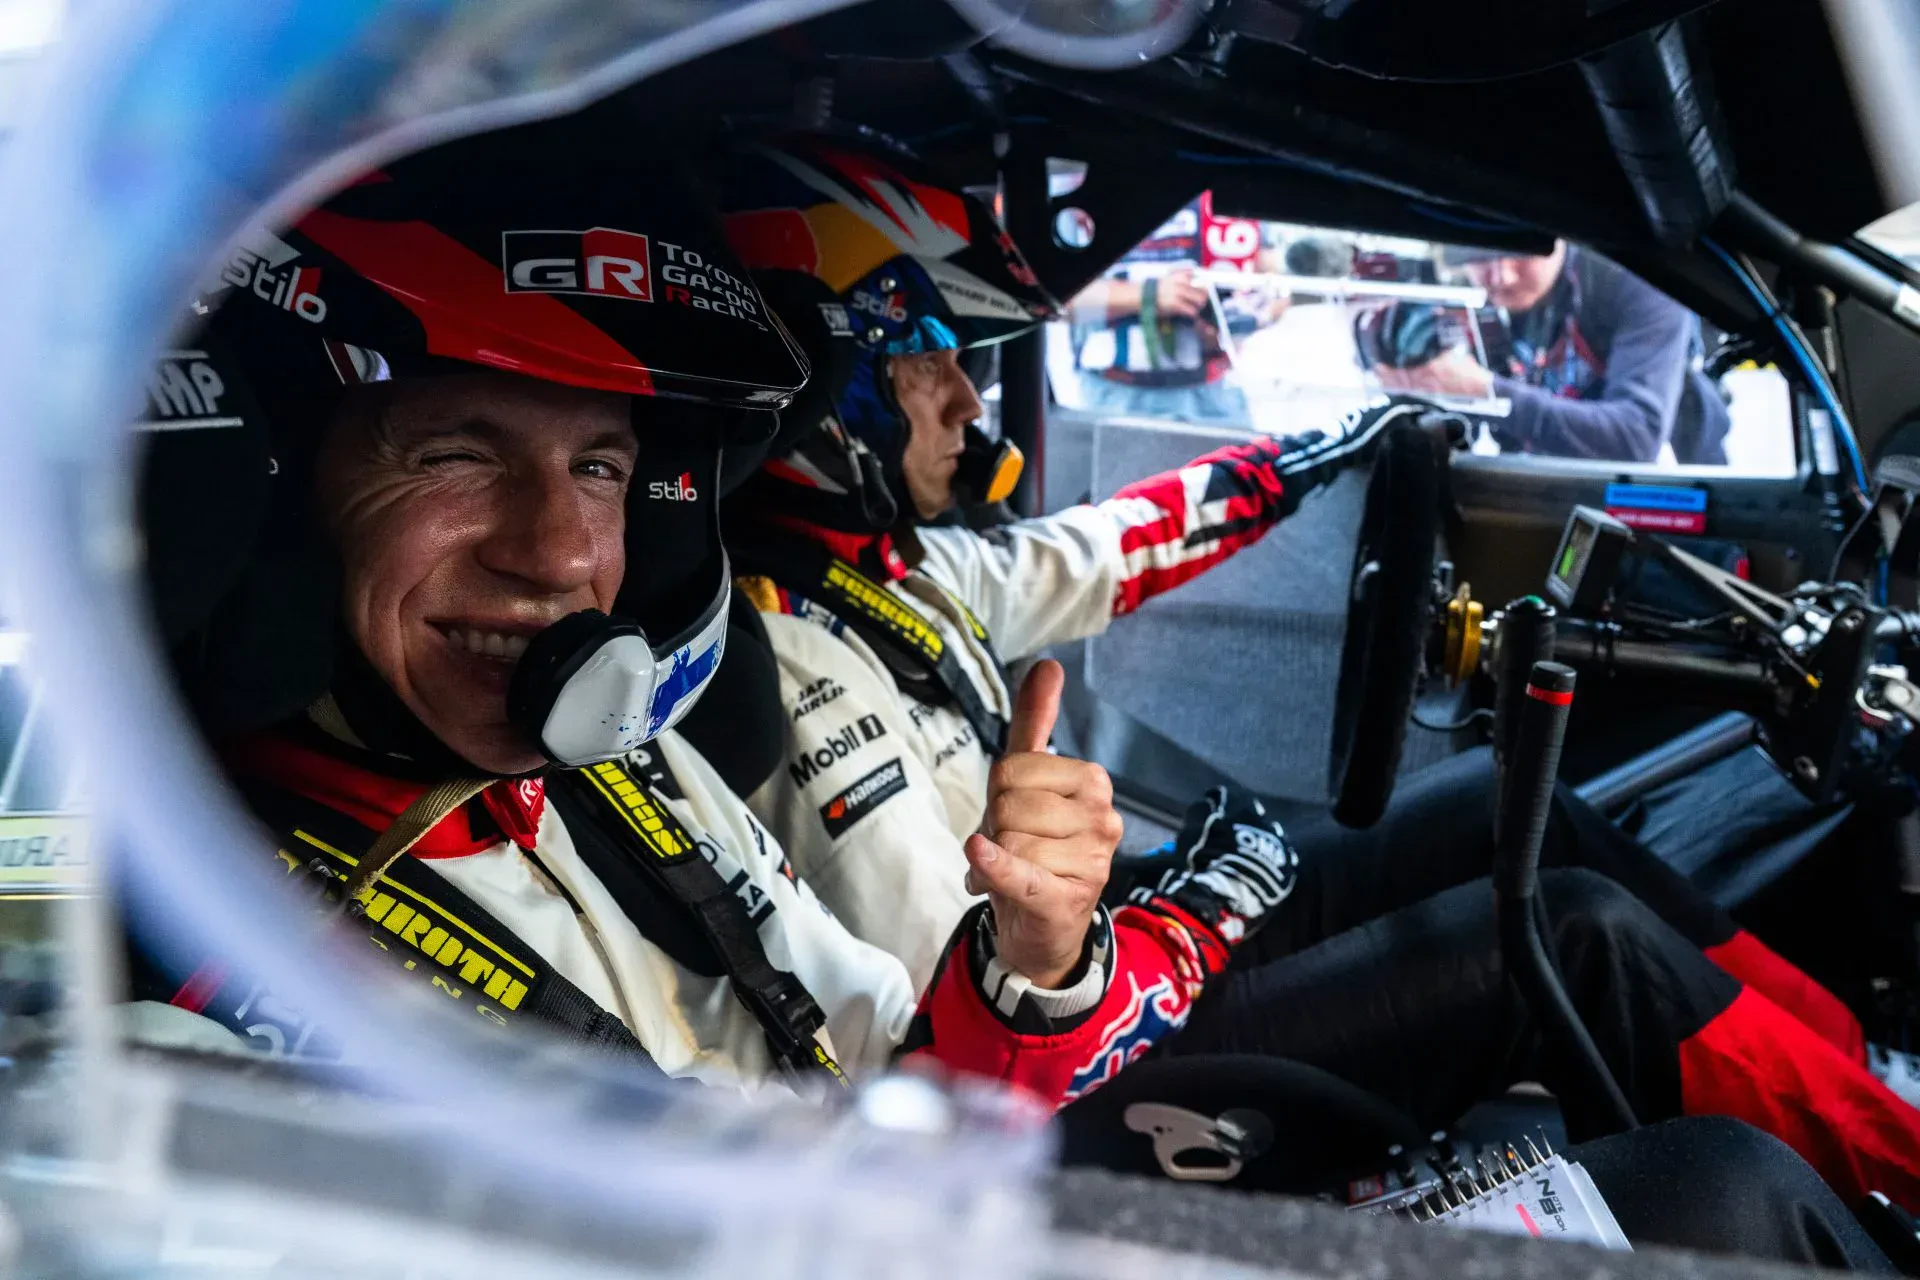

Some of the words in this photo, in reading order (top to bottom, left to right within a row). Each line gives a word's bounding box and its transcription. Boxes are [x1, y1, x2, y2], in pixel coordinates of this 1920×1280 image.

[512, 254, 646, 296] GR
[658, 241, 757, 302] TOYOTA
[662, 264, 758, 315] GAZOO
[148, 361, 225, 416] MP
[788, 725, 861, 790] Mobil
[861, 715, 883, 740] 1
